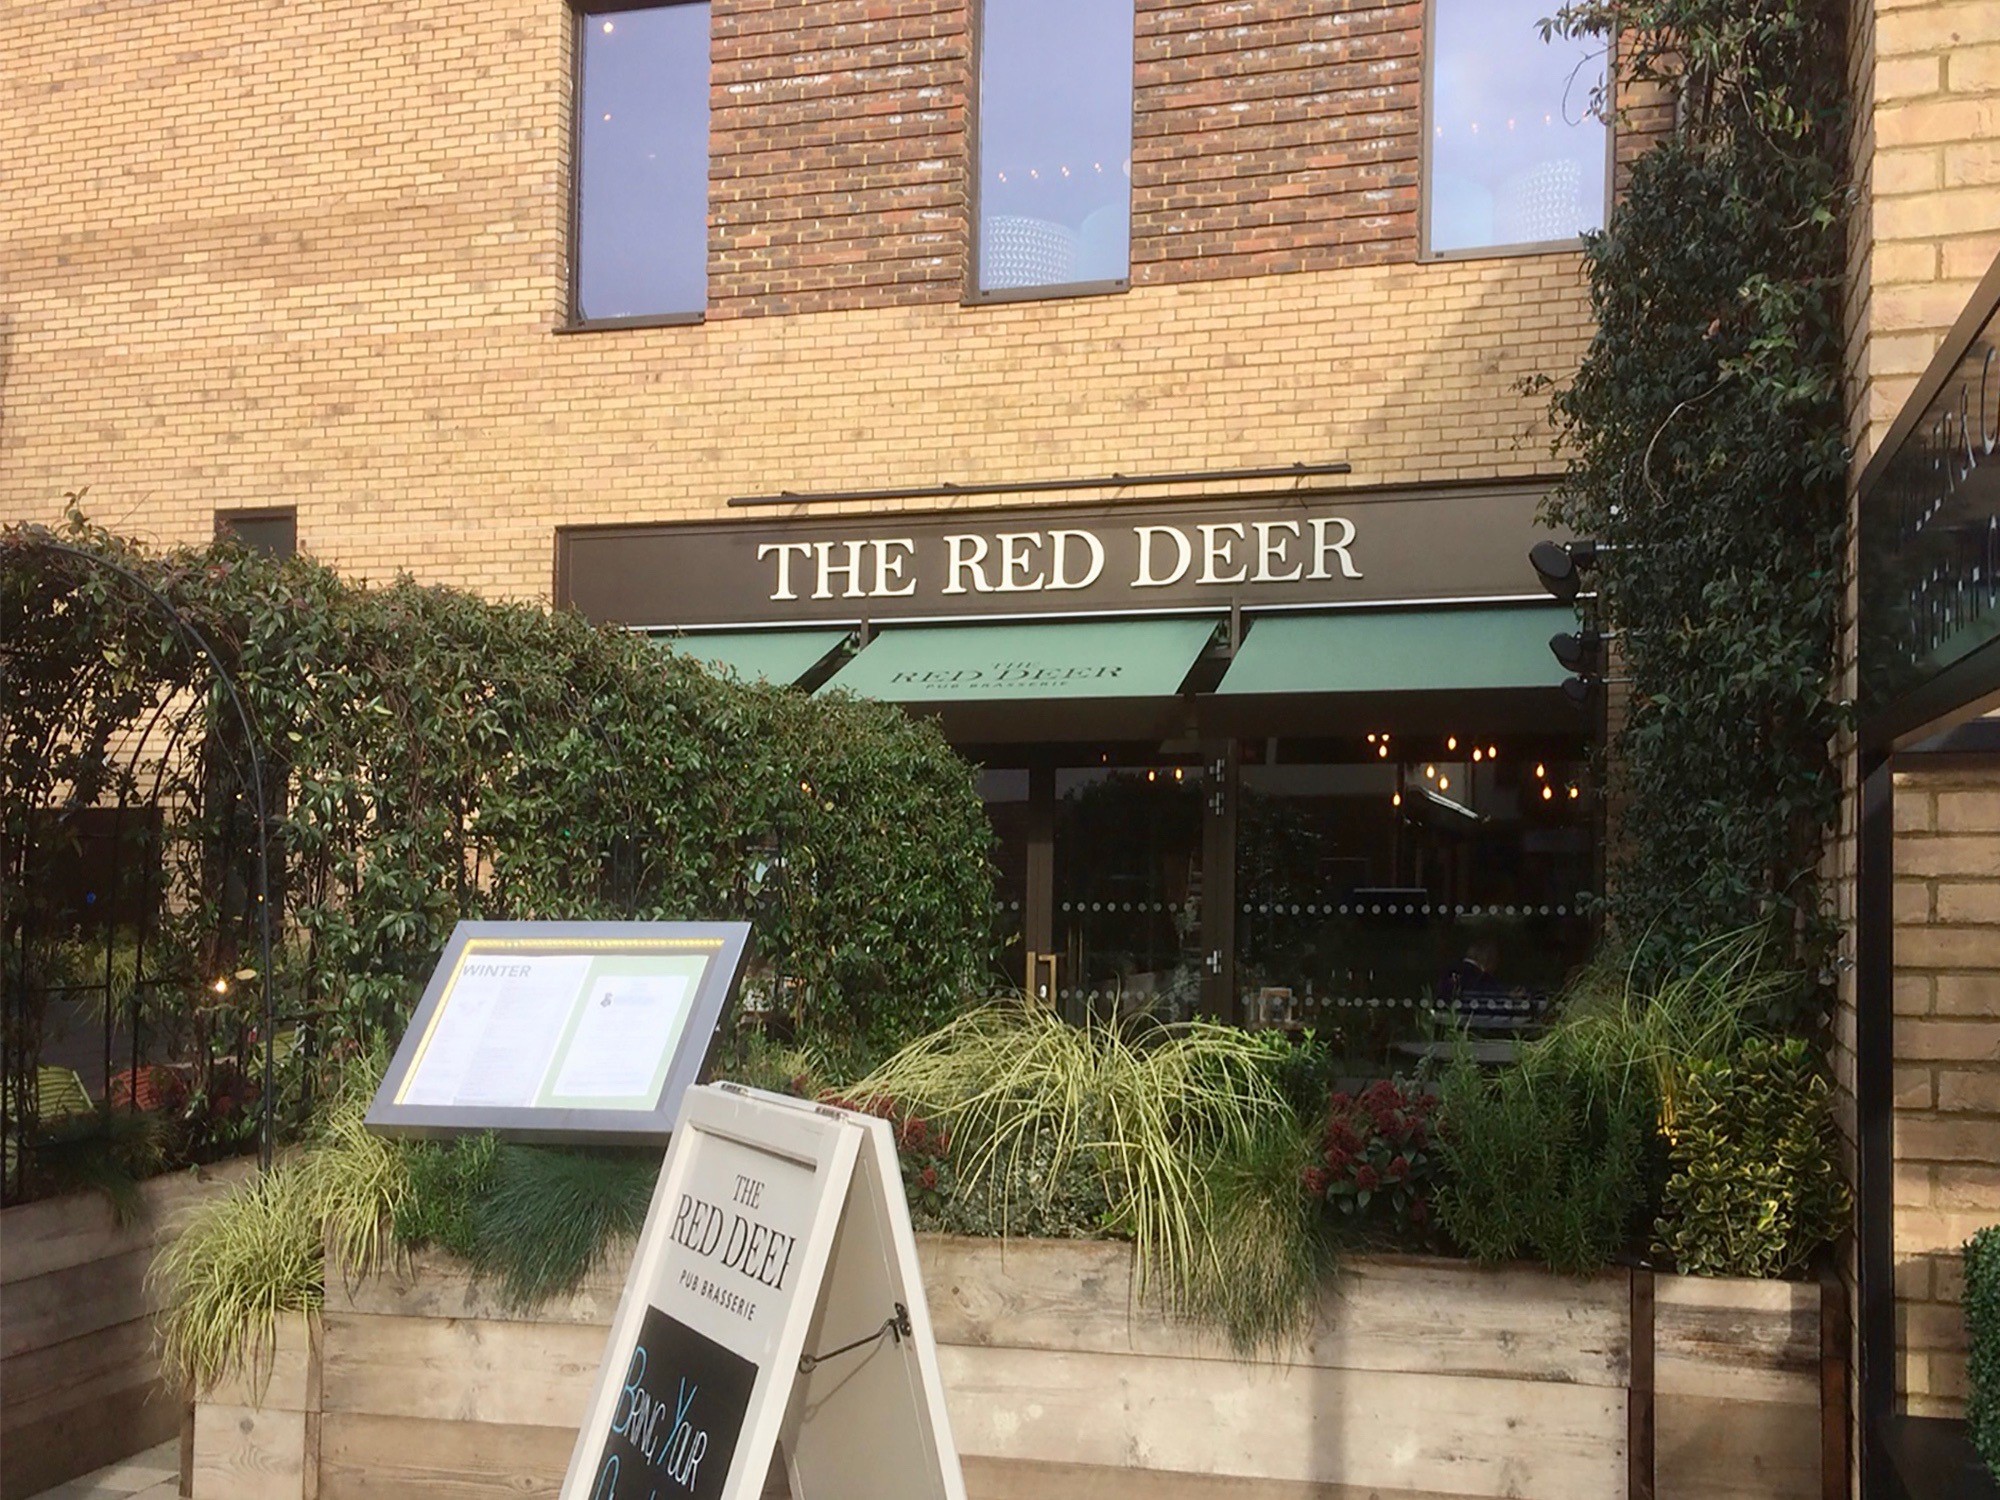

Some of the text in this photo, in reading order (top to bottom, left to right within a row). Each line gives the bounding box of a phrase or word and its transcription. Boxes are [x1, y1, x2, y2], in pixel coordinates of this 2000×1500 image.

[757, 517, 1363, 600] THE RED DEER
[891, 666, 1123, 683] RED DEER
[463, 964, 532, 978] WINTER
[733, 1173, 765, 1210] THE
[669, 1194, 724, 1257] RED
[679, 1269, 757, 1321] PUB BRASSERIE
[657, 1376, 708, 1492] YOUR
